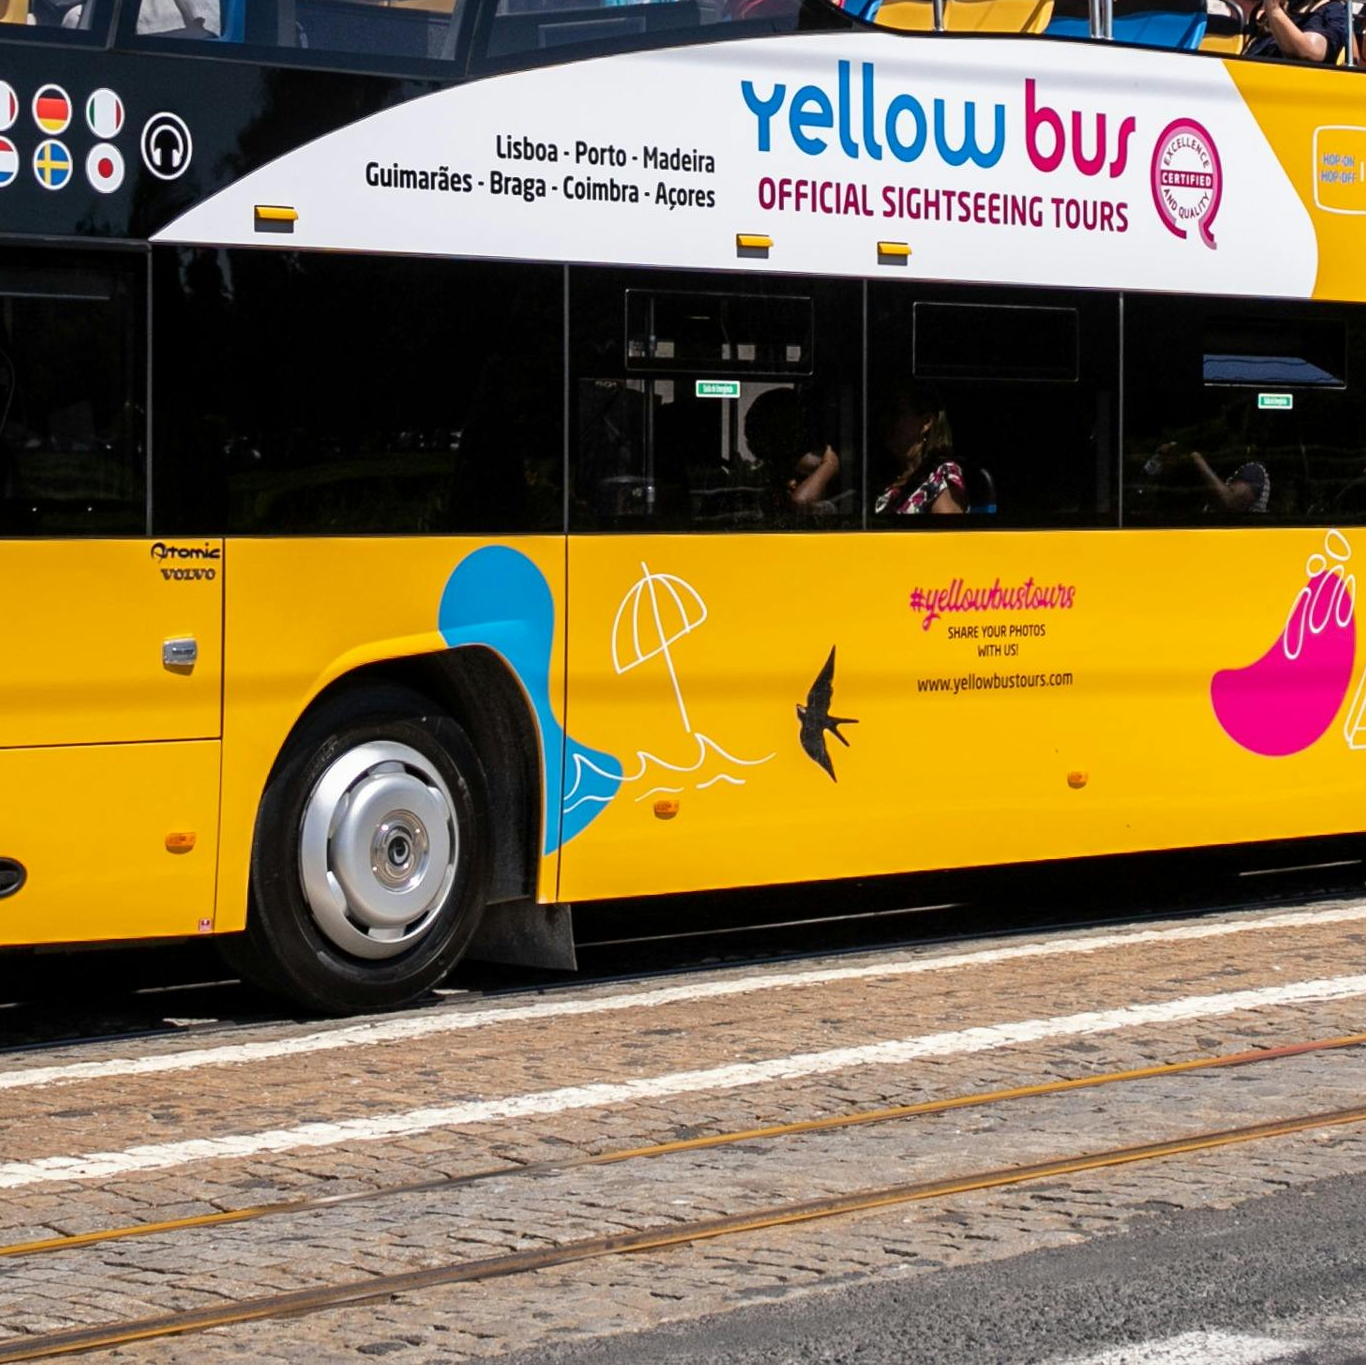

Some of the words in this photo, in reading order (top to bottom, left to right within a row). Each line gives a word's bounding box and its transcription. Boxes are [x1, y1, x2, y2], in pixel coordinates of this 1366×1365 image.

[1025, 78, 1136, 178] bus
[496, 135, 558, 162] Lisboa
[575, 141, 627, 166] Porto
[643, 146, 715, 173] Madeira
[1163, 137, 1210, 168] EXCELLENCE
[1322, 153, 1355, 167] HOP-ON
[366, 162, 473, 193] Guimarães
[490, 171, 546, 202] Braga
[563, 176, 639, 203] Coimbra
[655, 182, 715, 211] Açores
[1162, 172, 1212, 187] CERTIFIED
[1321, 171, 1356, 184] HOP-OFF
[758, 176, 874, 217] OFFICIAL
[882, 185, 1043, 227] SIGHTSEEING
[1051, 197, 1128, 233] TOURS
[1163, 188, 1178, 210] AND
[1178, 191, 1210, 219] QUALITY
[151, 542, 220, 563] Atomic
[160, 568, 216, 580] VOLVO
[910, 576, 1076, 631] #yellowbustours
[948, 625, 979, 639] SHARE
[981, 625, 1006, 638] YOUR
[1009, 624, 1046, 637] PHOTOS
[978, 644, 1002, 657] WITH
[1004, 643, 1019, 656] US!
[917, 672, 1073, 694] www.yellowbustours.com
